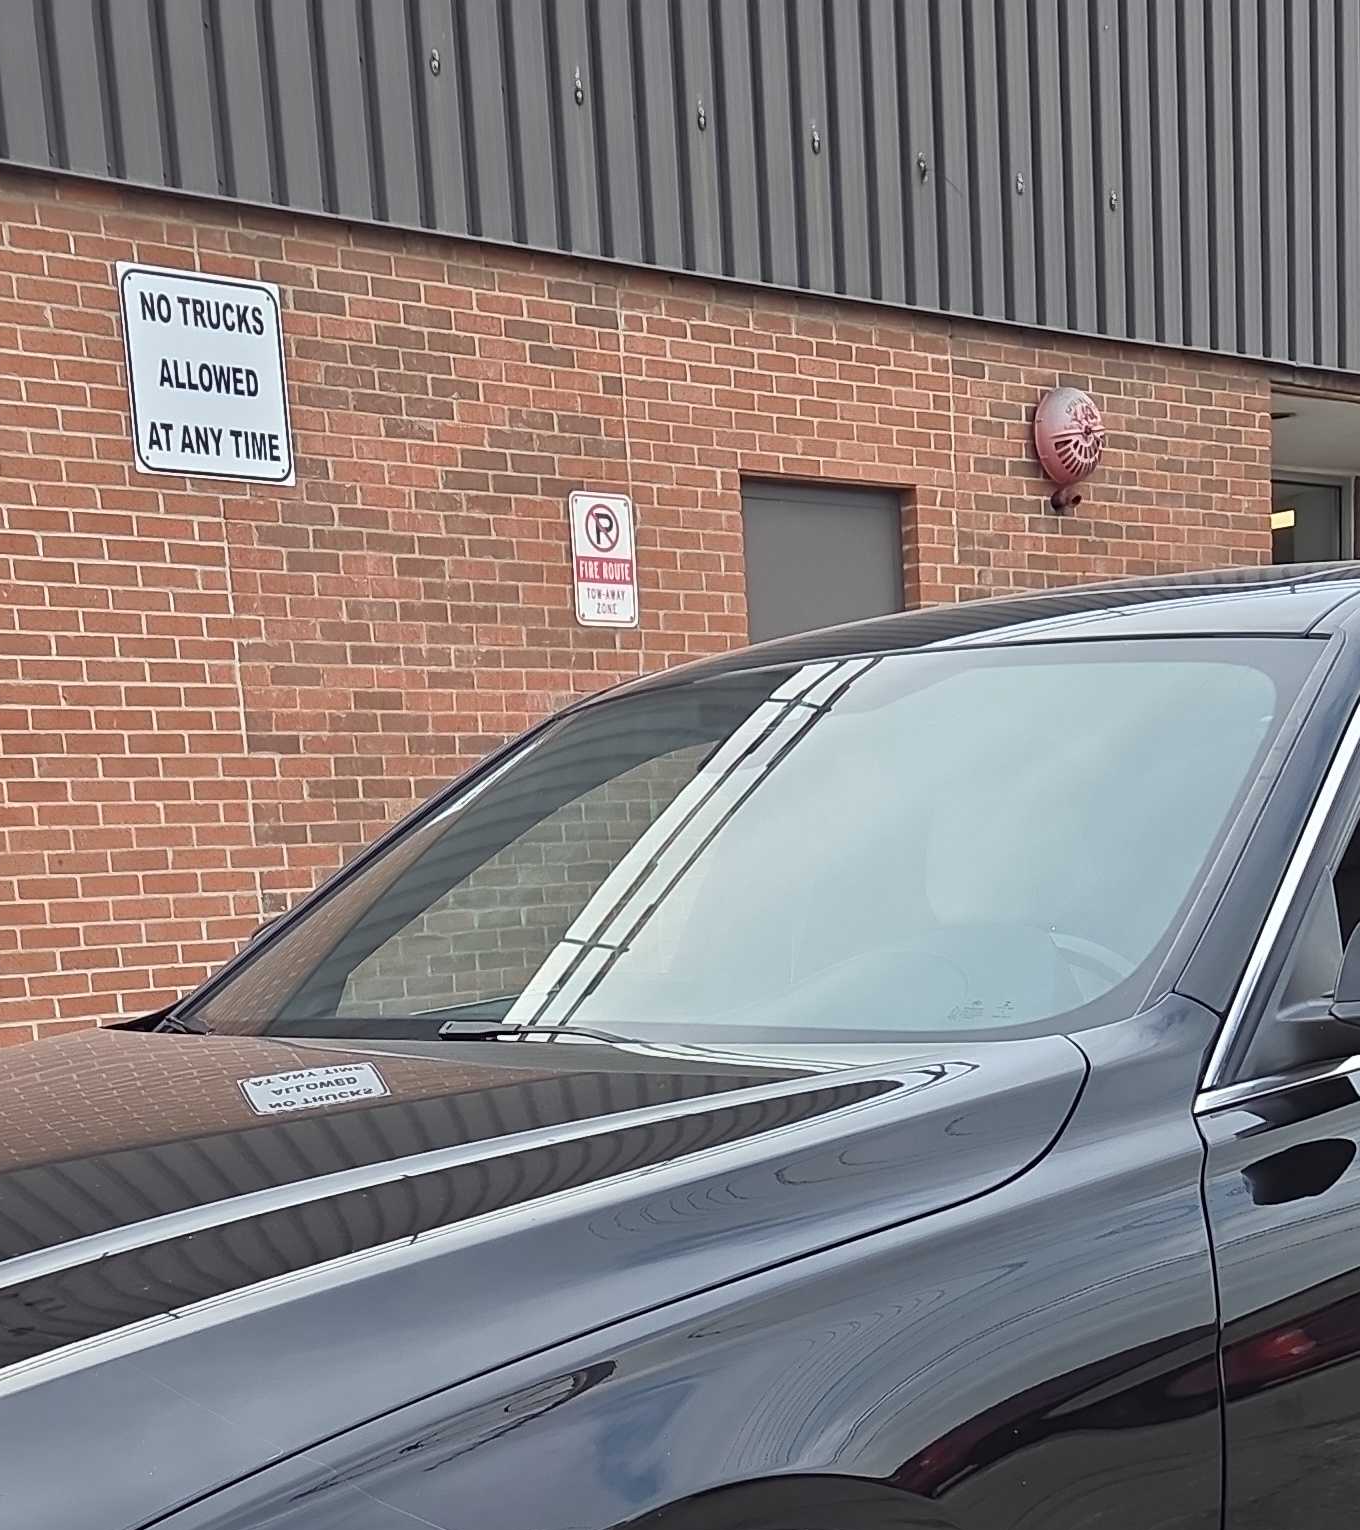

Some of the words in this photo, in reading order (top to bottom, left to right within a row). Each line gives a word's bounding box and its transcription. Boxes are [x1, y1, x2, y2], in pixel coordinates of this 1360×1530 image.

[139, 291, 172, 323] NO
[177, 296, 265, 336] TRUCKS
[159, 358, 259, 397] ALLOWED
[148, 422, 173, 451] AT
[181, 425, 223, 457] ANY
[230, 430, 281, 462] TIME
[579, 560, 599, 579] FIRE
[602, 561, 631, 581] ROUTE
[587, 587, 626, 601] TOW-AWAY
[596, 602, 618, 615] ZONE
